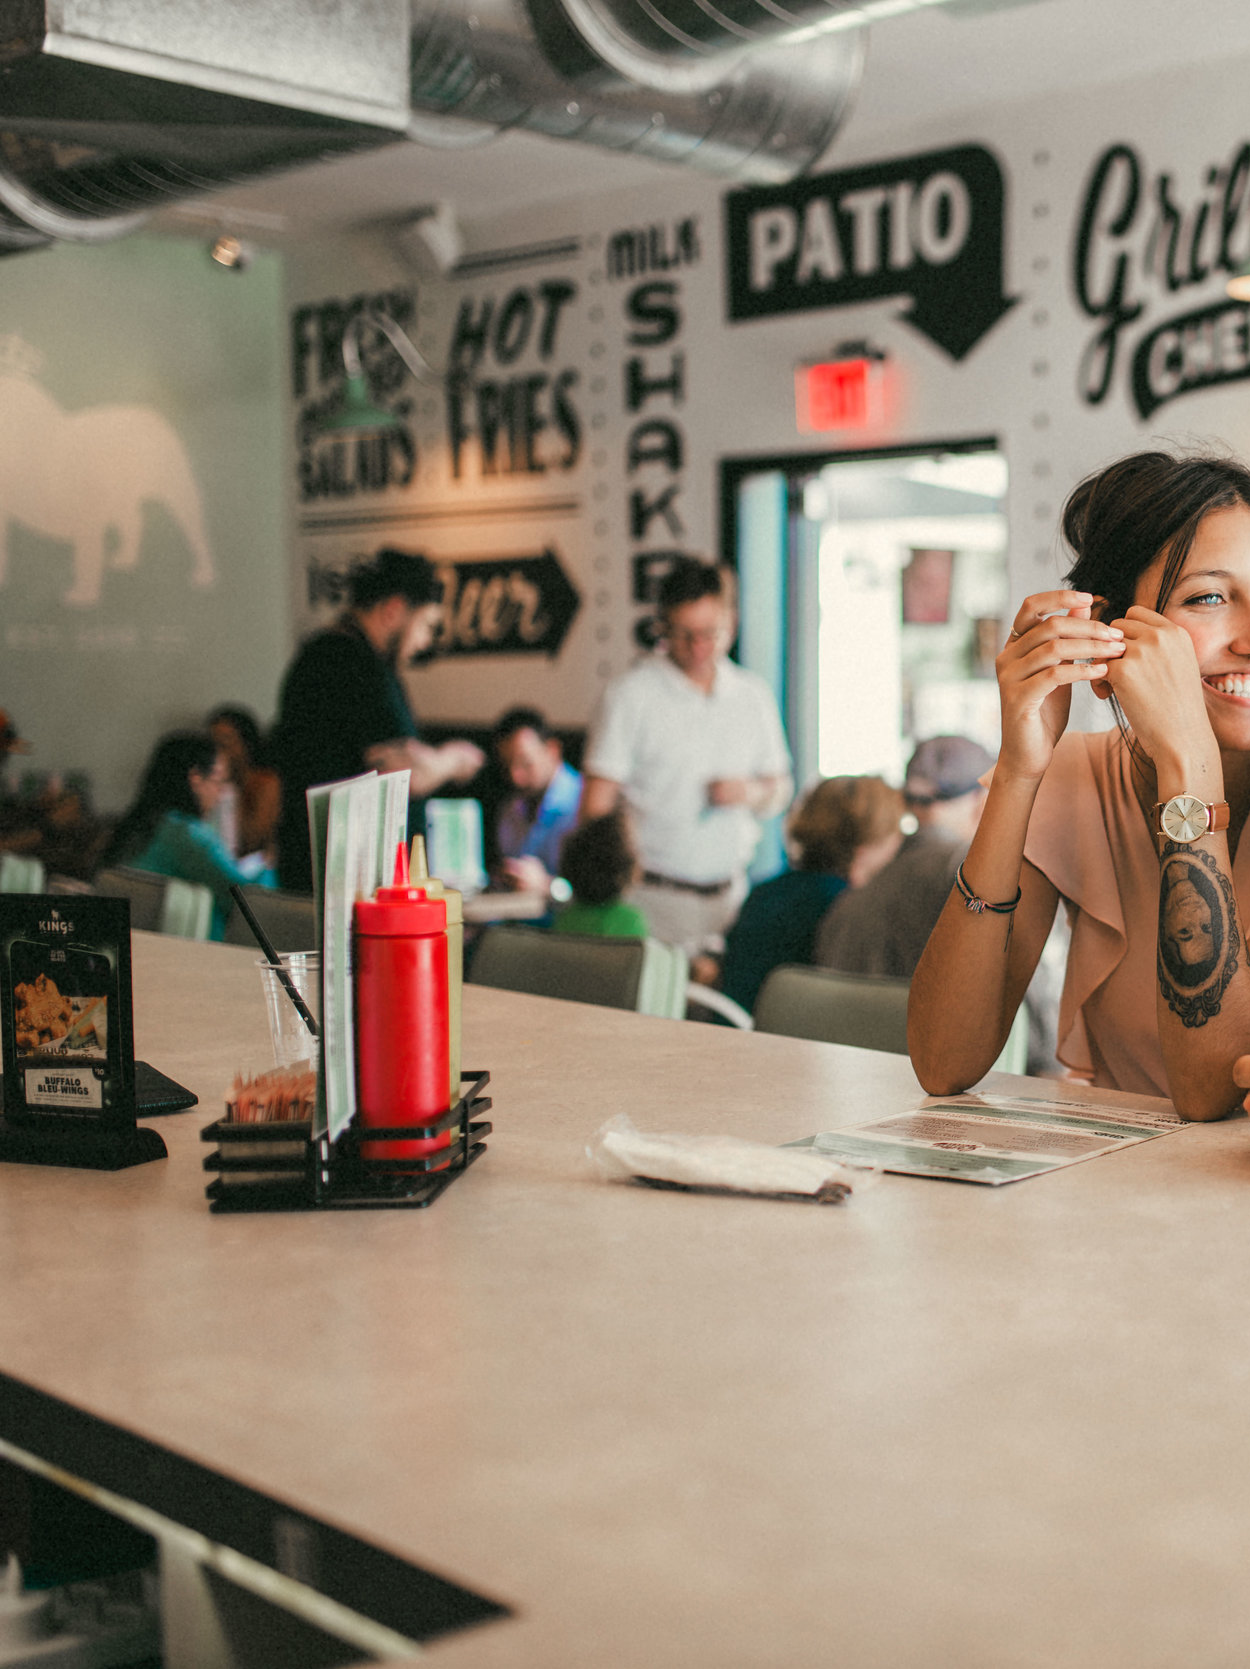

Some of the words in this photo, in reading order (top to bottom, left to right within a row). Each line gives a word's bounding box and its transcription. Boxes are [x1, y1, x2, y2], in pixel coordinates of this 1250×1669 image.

[607, 214, 700, 282] MILK
[749, 171, 974, 293] PATIO
[448, 279, 578, 365] HOT
[445, 367, 581, 481] FRIES
[38, 920, 75, 935] KINGS
[37, 1084, 90, 1097] BLEU-WINGS
[44, 1076, 82, 1087] BUFFALO
